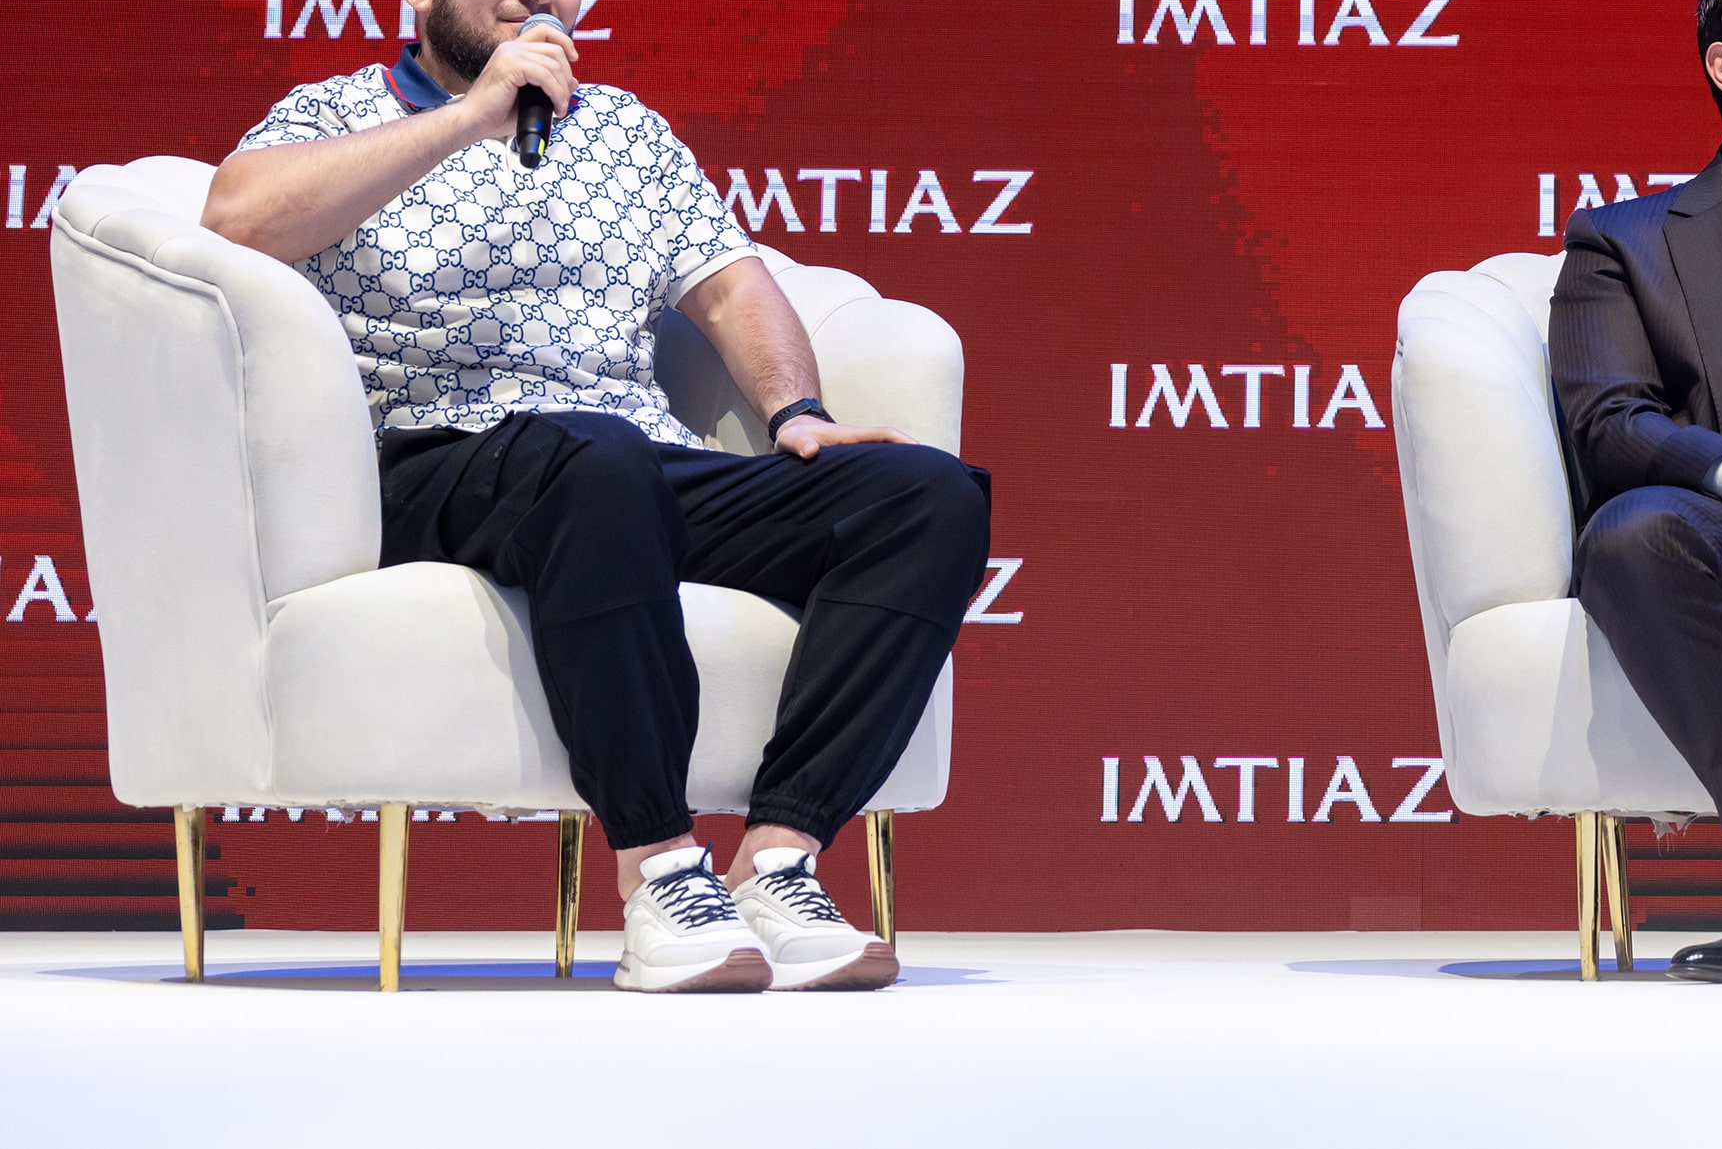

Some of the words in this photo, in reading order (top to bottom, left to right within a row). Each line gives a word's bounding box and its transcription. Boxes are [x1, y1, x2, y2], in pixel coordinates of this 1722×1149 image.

[702, 168, 1034, 234] MTIAZ
[1109, 364, 1386, 428] IMTIA
[1100, 755, 1454, 822] IMTIAZ
